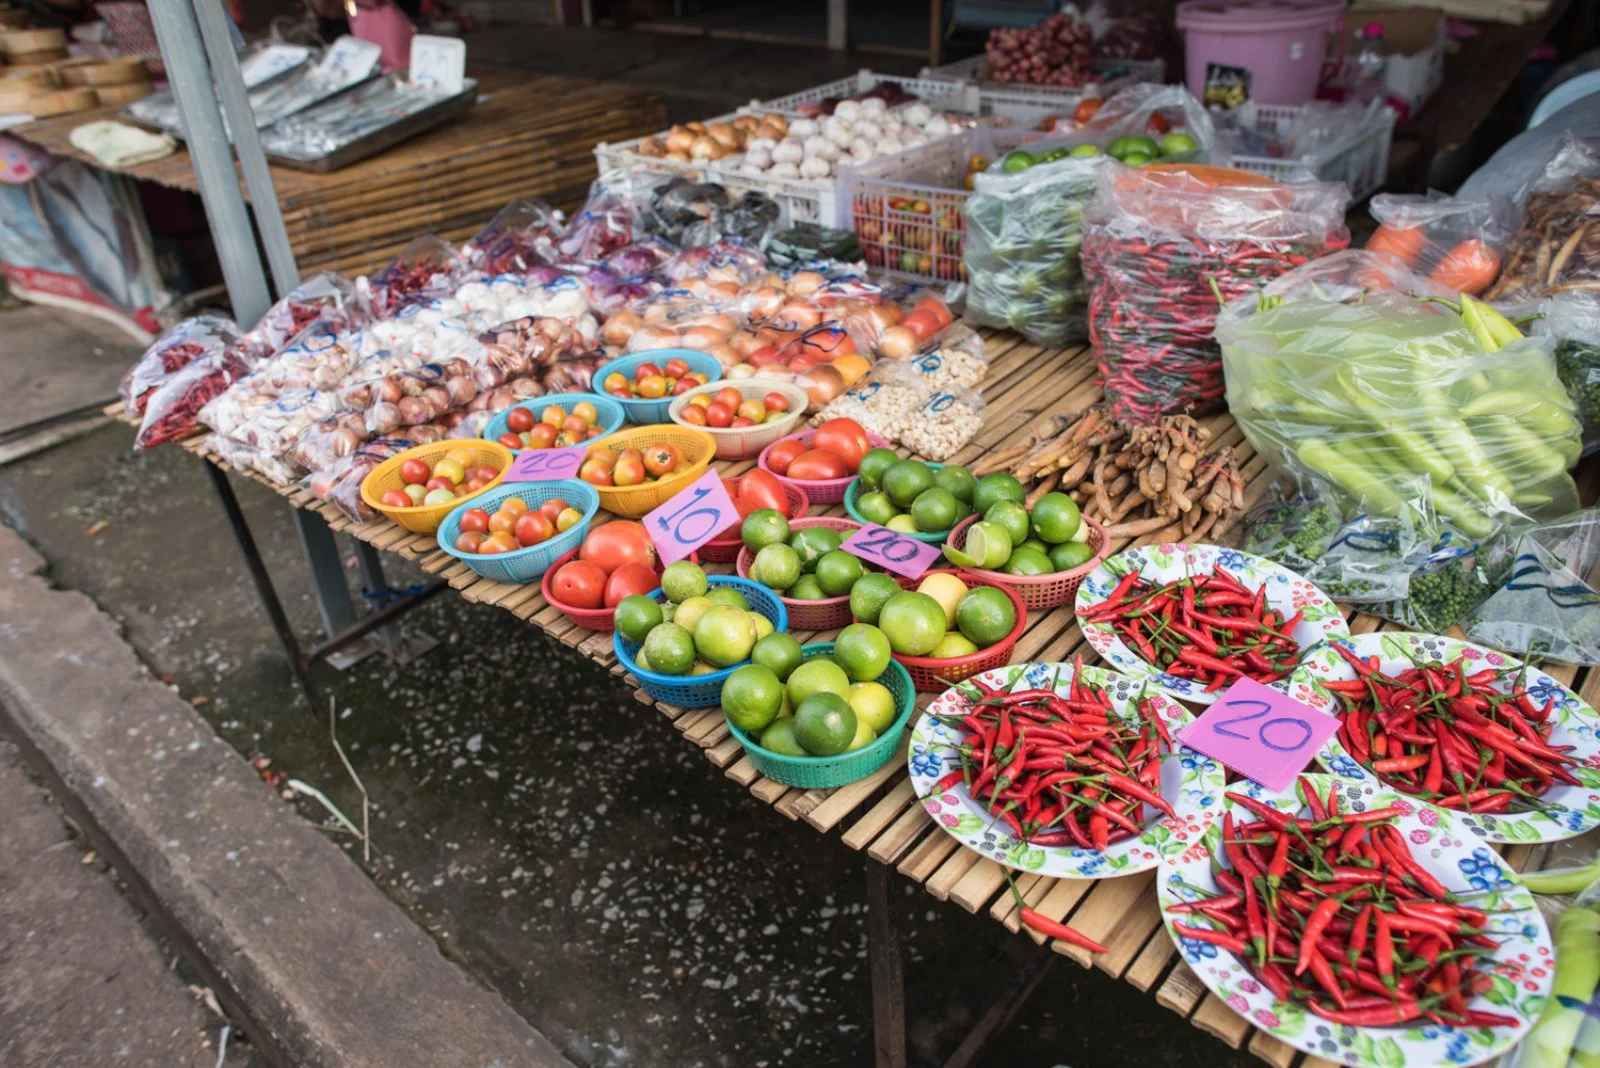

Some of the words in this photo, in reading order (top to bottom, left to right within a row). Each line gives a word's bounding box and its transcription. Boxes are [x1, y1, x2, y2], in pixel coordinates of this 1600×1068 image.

[519, 452, 580, 475] 20
[657, 487, 721, 545] 10
[853, 527, 920, 562] 20
[1212, 700, 1313, 752] 20
